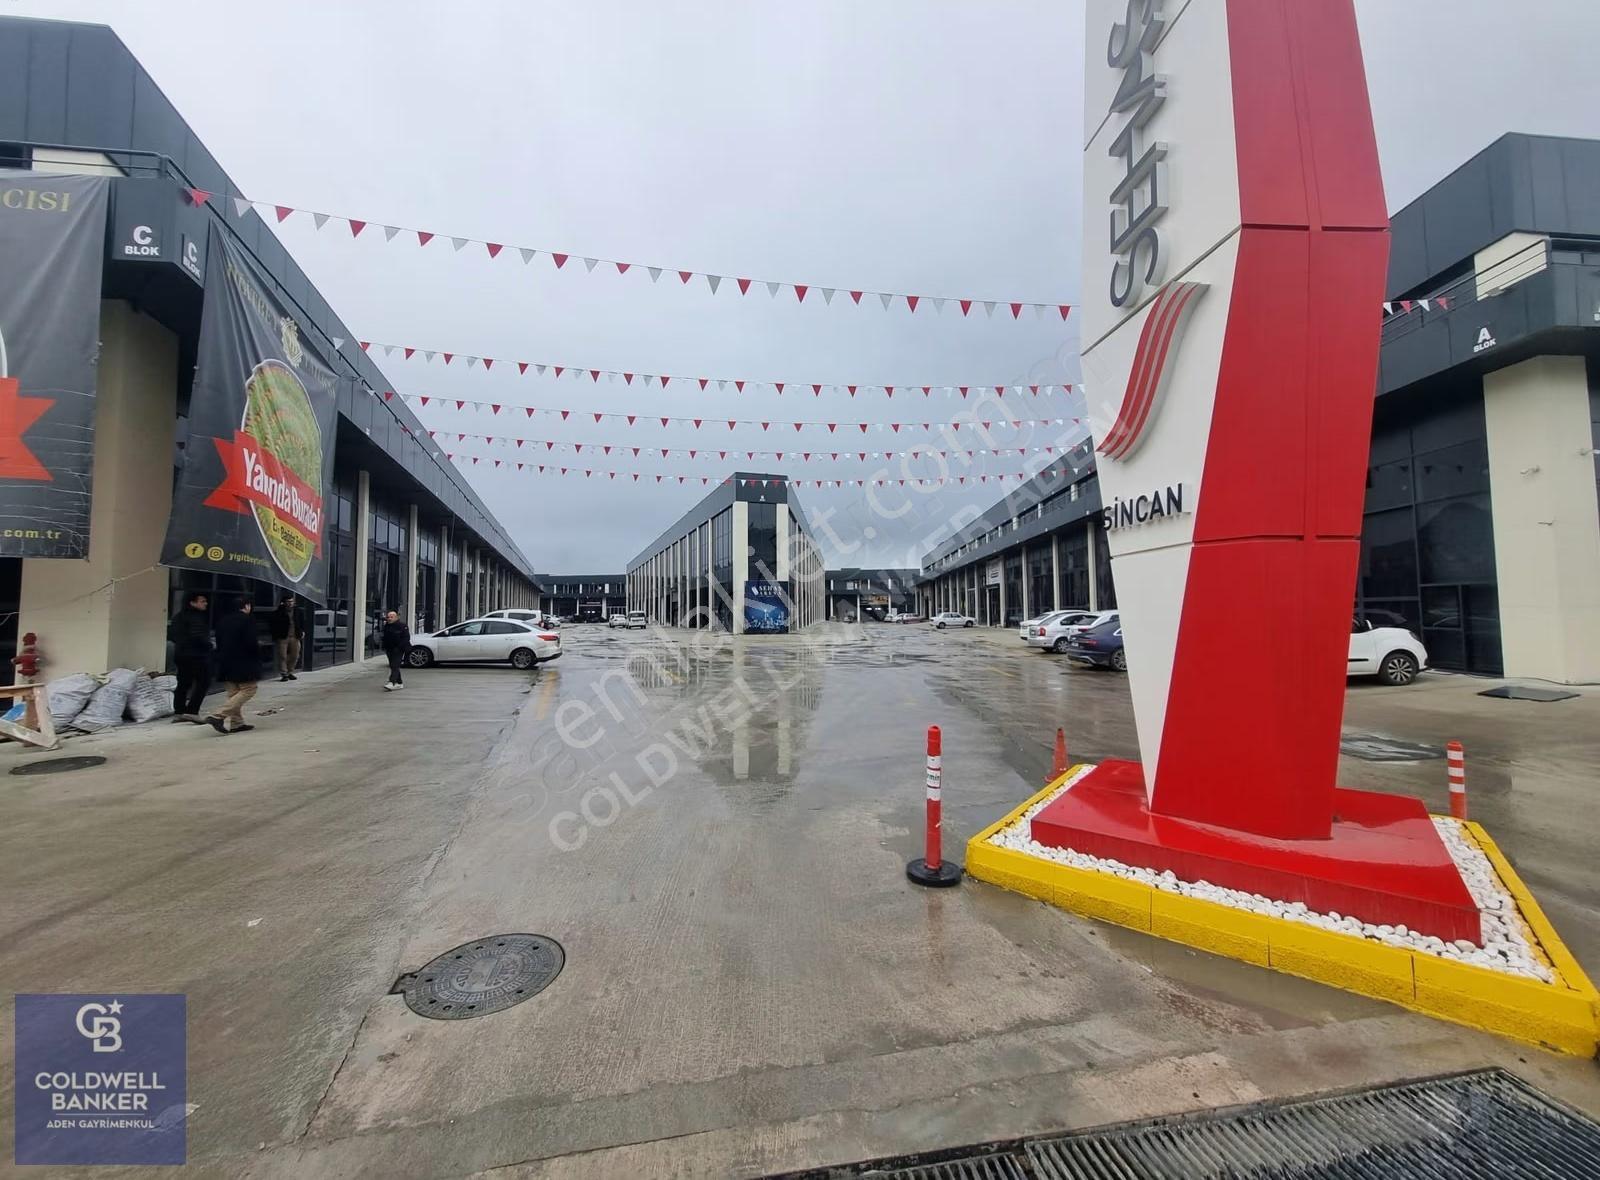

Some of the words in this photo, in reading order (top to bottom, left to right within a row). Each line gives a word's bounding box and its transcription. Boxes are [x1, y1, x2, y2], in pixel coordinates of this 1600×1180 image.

[133, 225, 152, 244] C
[125, 246, 160, 256] BLOK
[187, 242, 198, 263] C
[182, 255, 201, 276] BLOK
[1477, 327, 1491, 344] A
[1473, 338, 1497, 353] BLOK
[1103, 483, 1183, 531] SİNCAN
